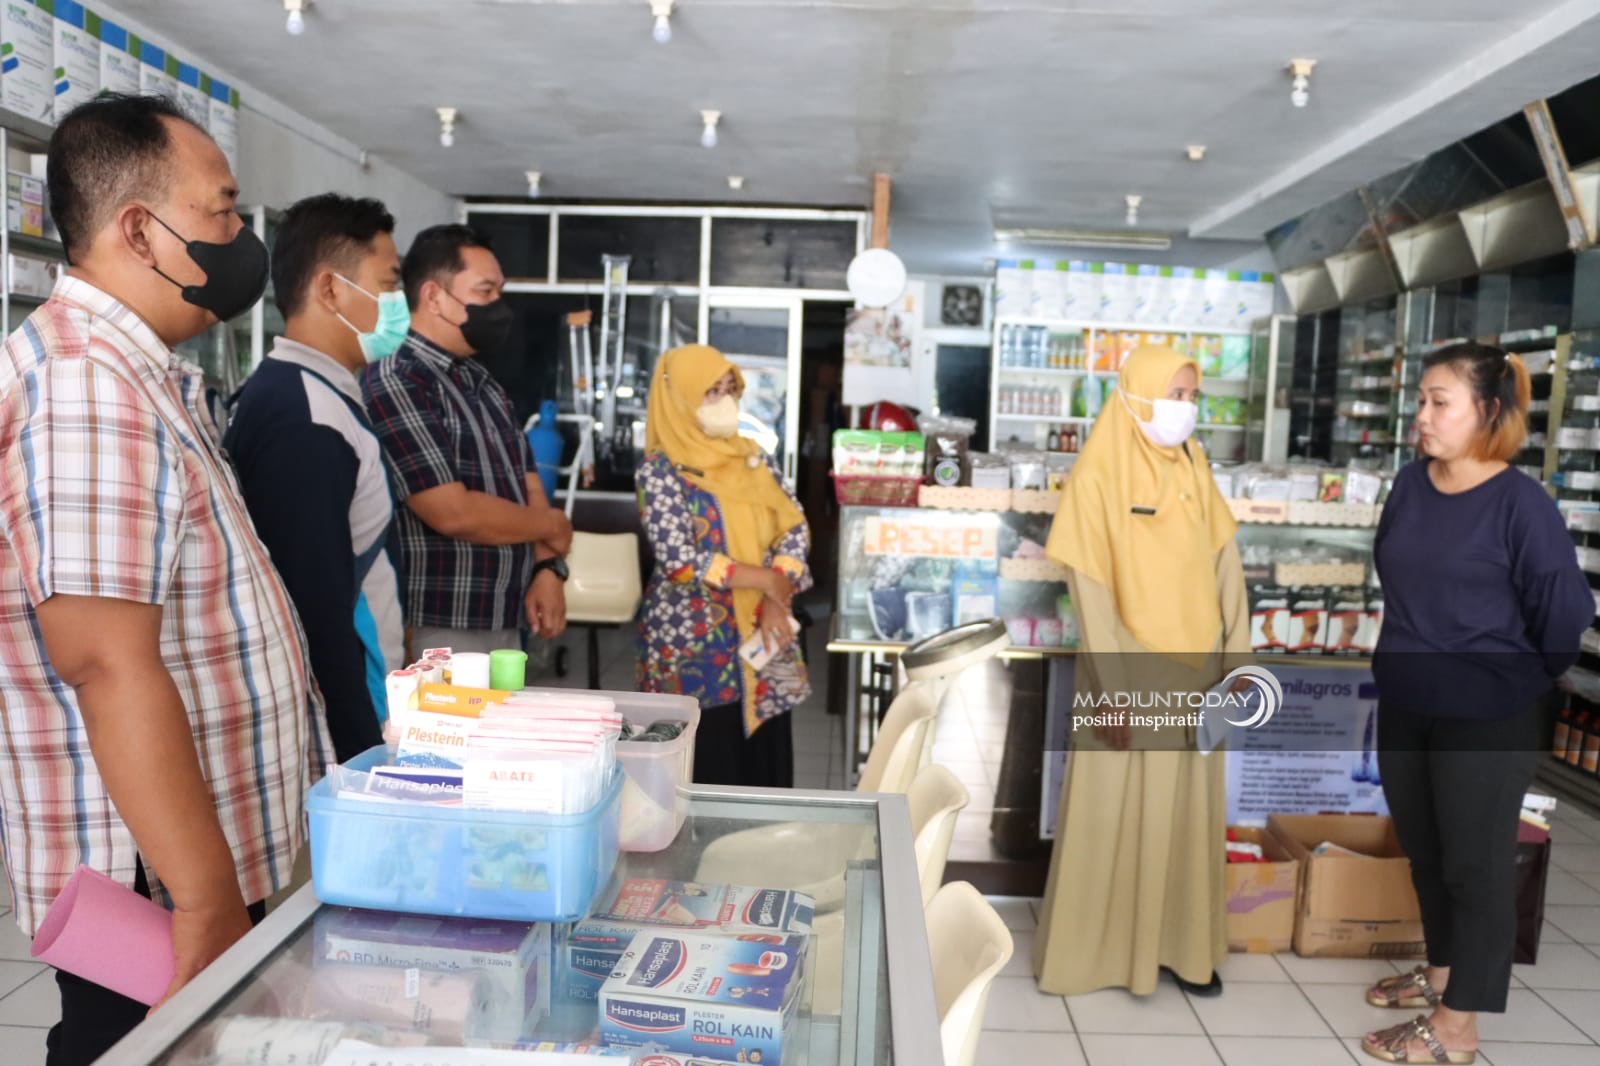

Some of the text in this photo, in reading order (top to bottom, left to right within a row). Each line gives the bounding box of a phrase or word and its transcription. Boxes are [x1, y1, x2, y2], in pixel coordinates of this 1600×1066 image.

[879, 521, 983, 556] RESEP
[1281, 678, 1353, 700] milagros
[407, 727, 465, 747] Plesterin
[636, 941, 675, 984] Hansaplast
[611, 1004, 681, 1023] Hansaplast
[693, 1011, 725, 1020] PLESTER
[693, 1019, 774, 1041] ROL KAIN
